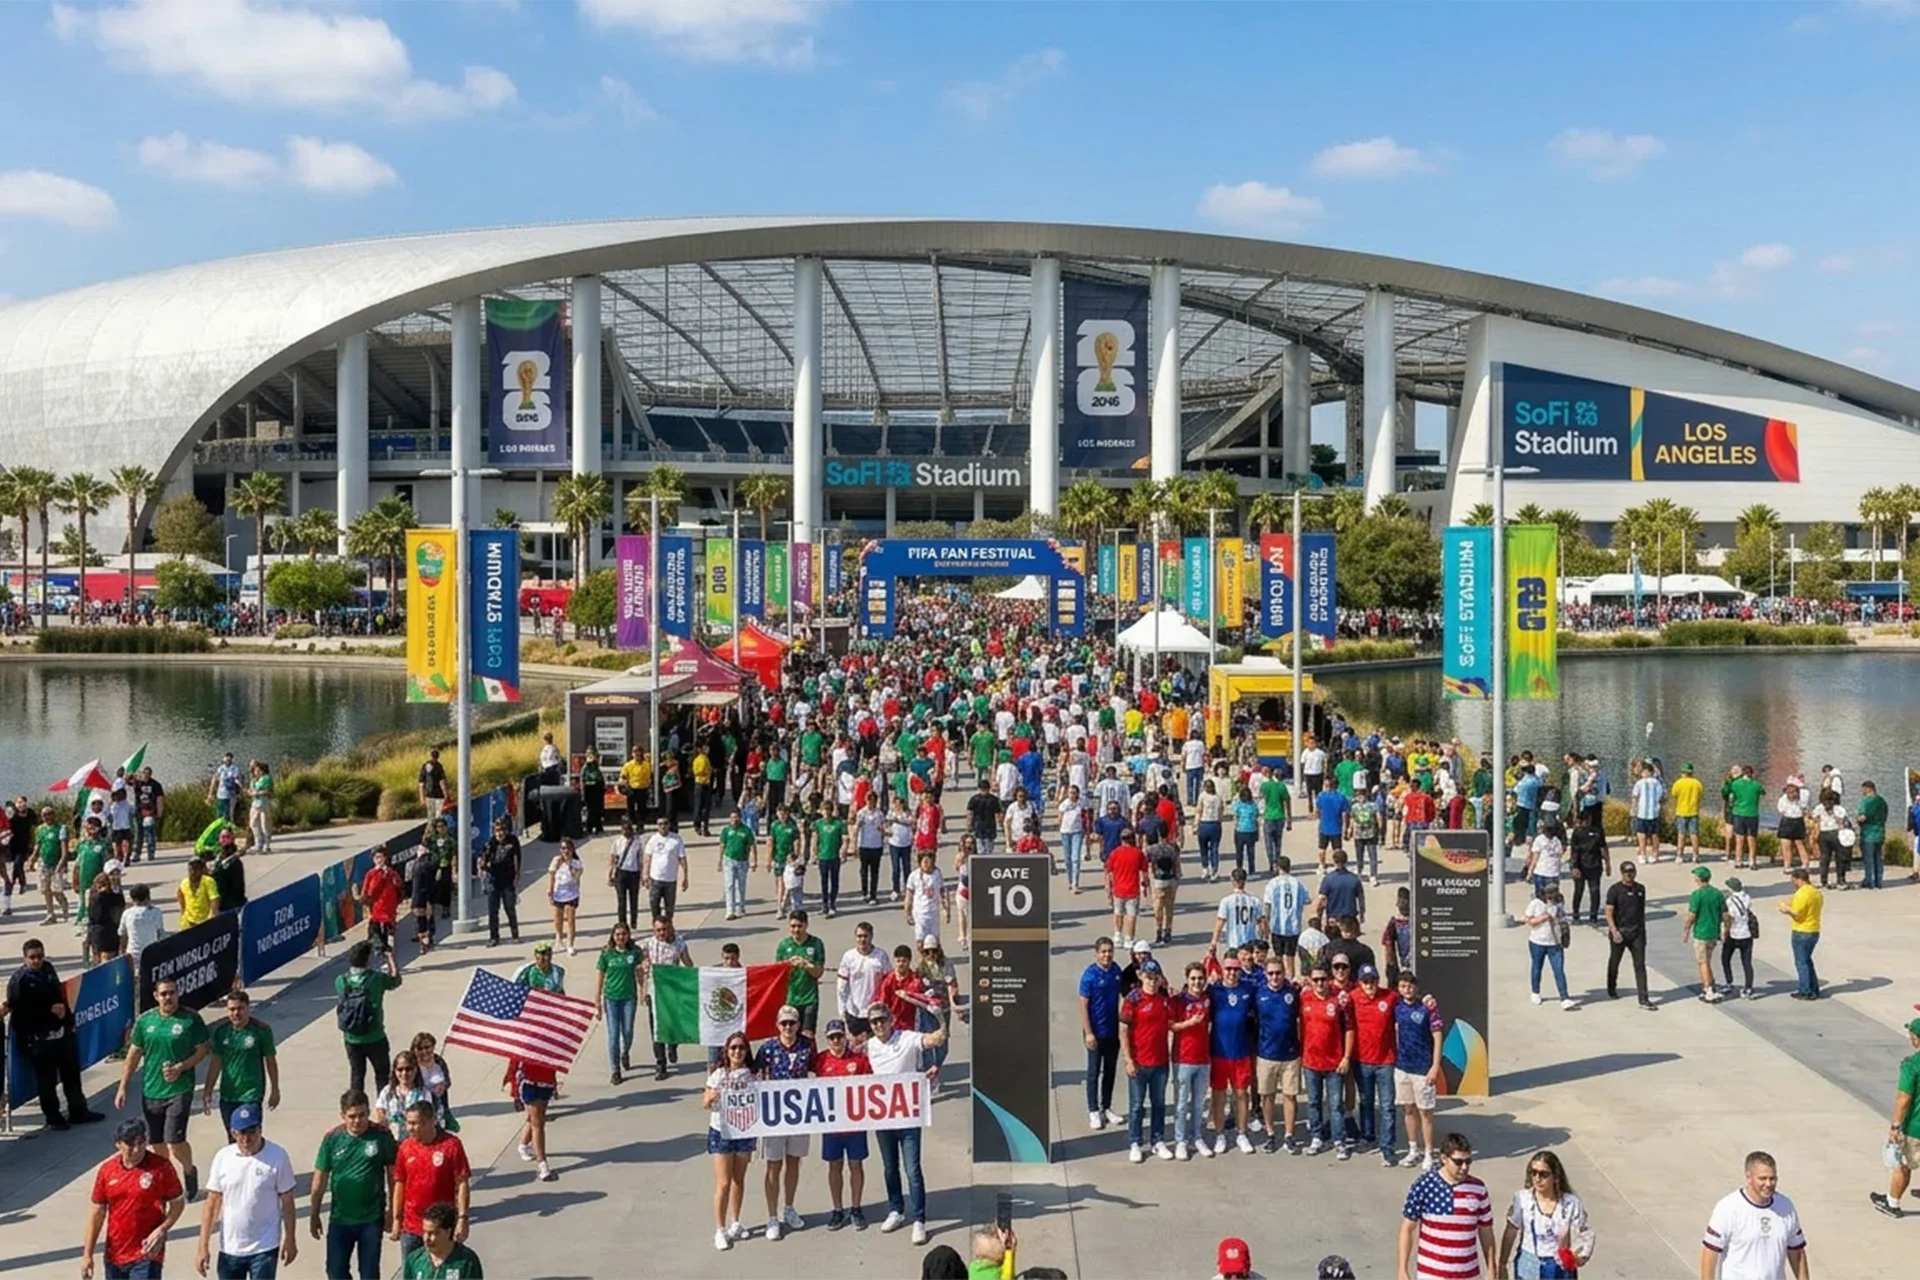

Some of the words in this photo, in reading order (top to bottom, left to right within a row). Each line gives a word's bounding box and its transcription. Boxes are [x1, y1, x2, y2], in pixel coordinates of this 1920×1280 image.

[1515, 401, 1569, 426] SoFi
[1515, 430, 1618, 455] Stadium
[1684, 422, 1727, 442] LOS
[1655, 445, 1757, 465] ANGELES
[916, 462, 1021, 486] Stadium
[971, 547, 1036, 560] FESTIVAL
[990, 868, 1030, 880] GATE
[988, 884, 1033, 917] 10
[761, 1086, 836, 1127] USA!
[846, 1081, 920, 1121] USA!
